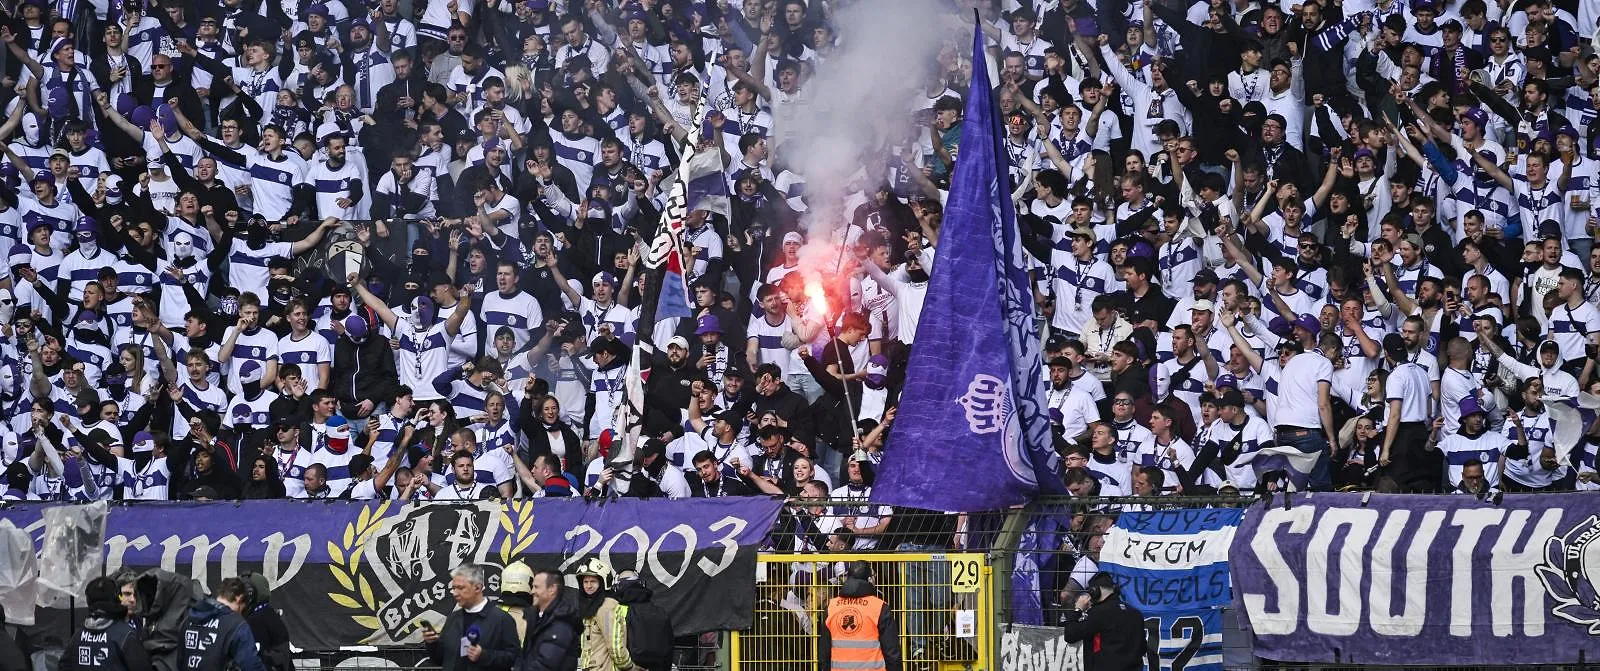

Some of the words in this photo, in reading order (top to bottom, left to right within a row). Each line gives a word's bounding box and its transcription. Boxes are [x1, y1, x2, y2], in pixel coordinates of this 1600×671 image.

[557, 515, 748, 589] 2003
[1243, 505, 1564, 637] SOUTH
[953, 561, 979, 586] 29
[836, 599, 869, 607] STEWARD
[80, 631, 107, 643] MEDIA
[1143, 616, 1205, 671] 12
